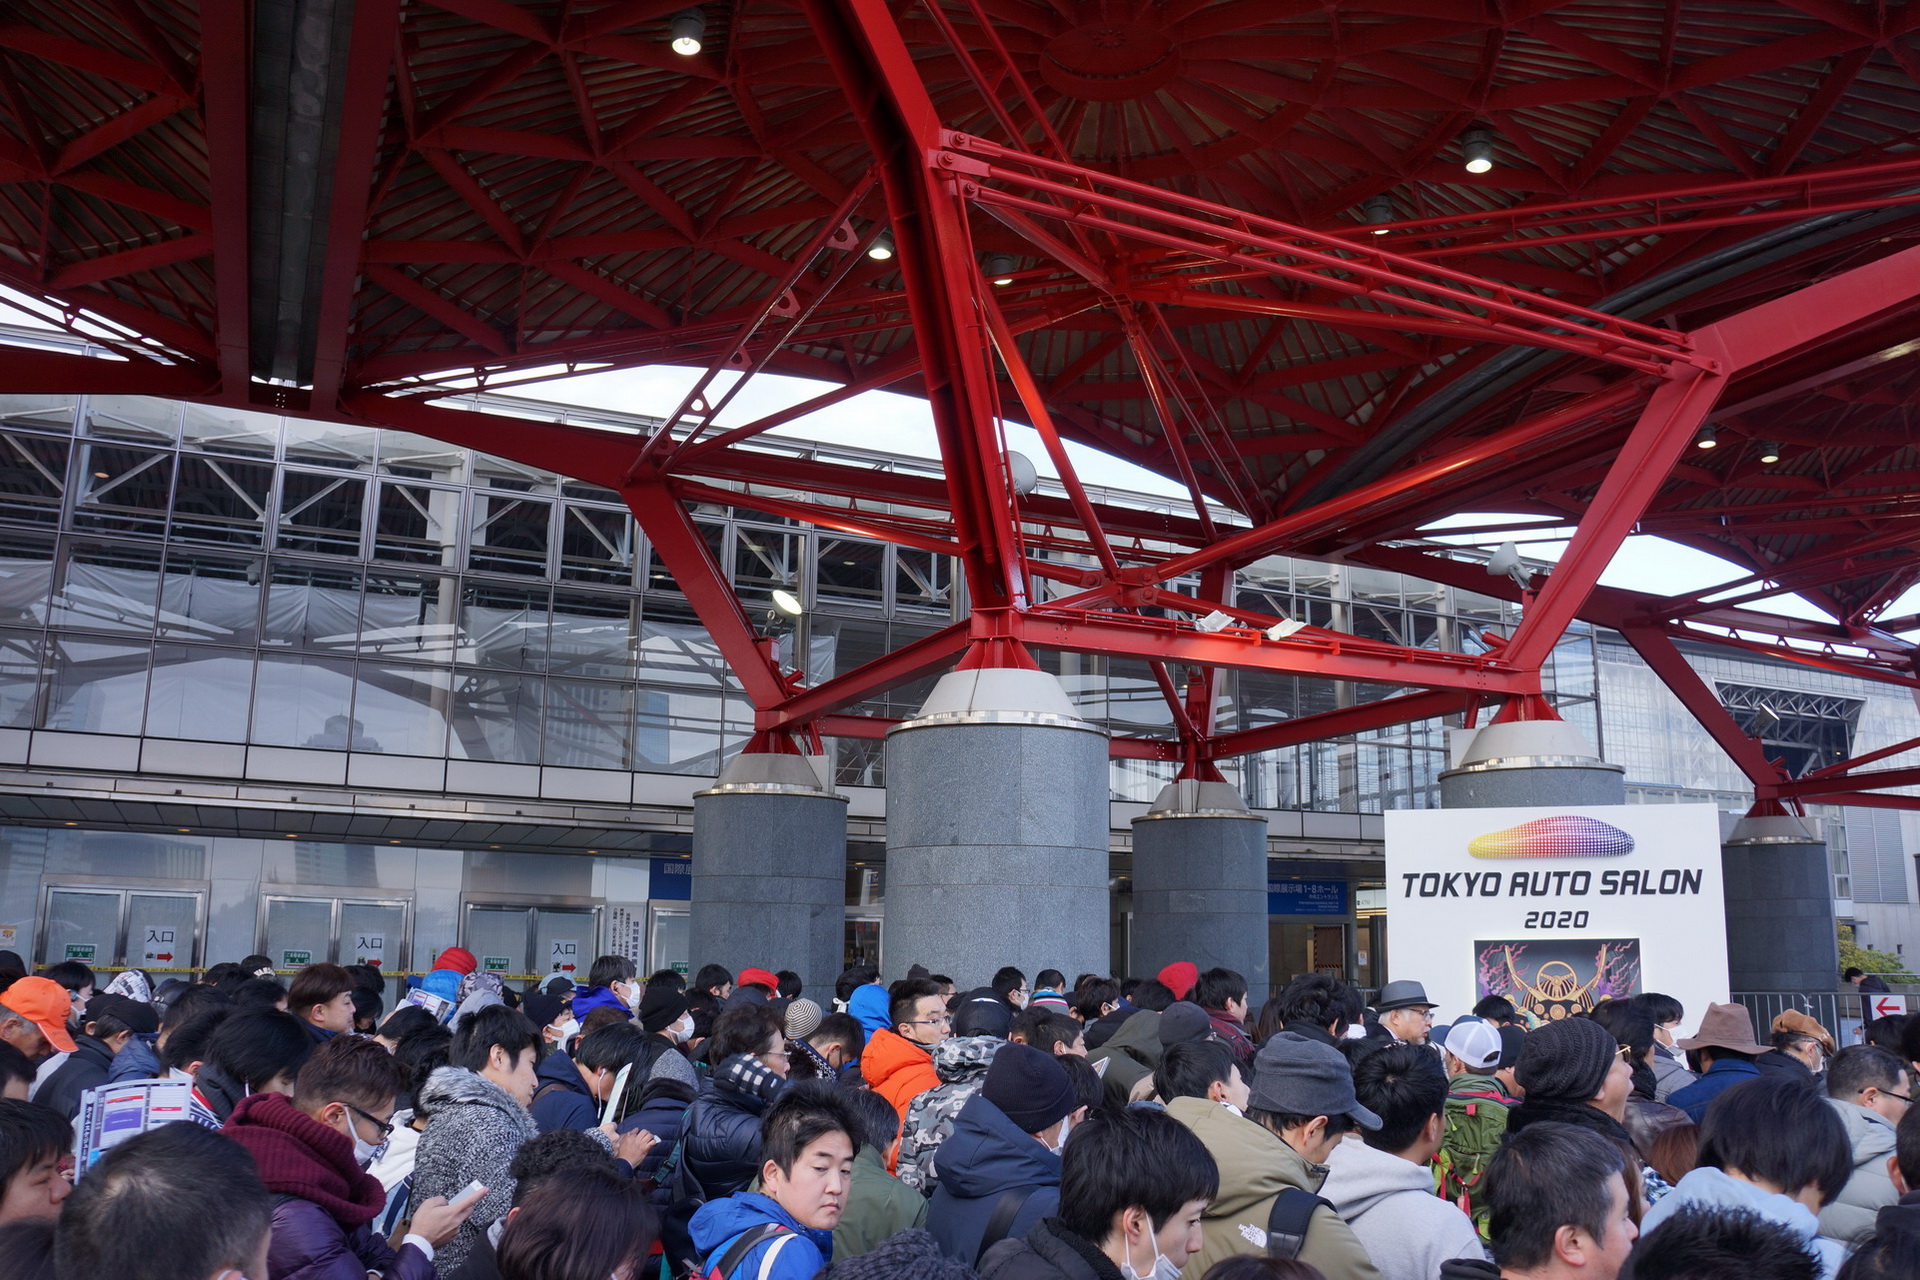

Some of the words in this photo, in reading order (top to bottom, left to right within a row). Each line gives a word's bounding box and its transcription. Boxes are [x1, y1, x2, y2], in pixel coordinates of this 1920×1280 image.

[1402, 872, 1501, 898] TOKYO
[1508, 871, 1592, 897] AUTO
[1600, 869, 1703, 896] SALON
[1524, 911, 1589, 929] 2020
[147, 930, 174, 943] 入口
[357, 937, 382, 949] 入口
[553, 943, 575, 955] 入口
